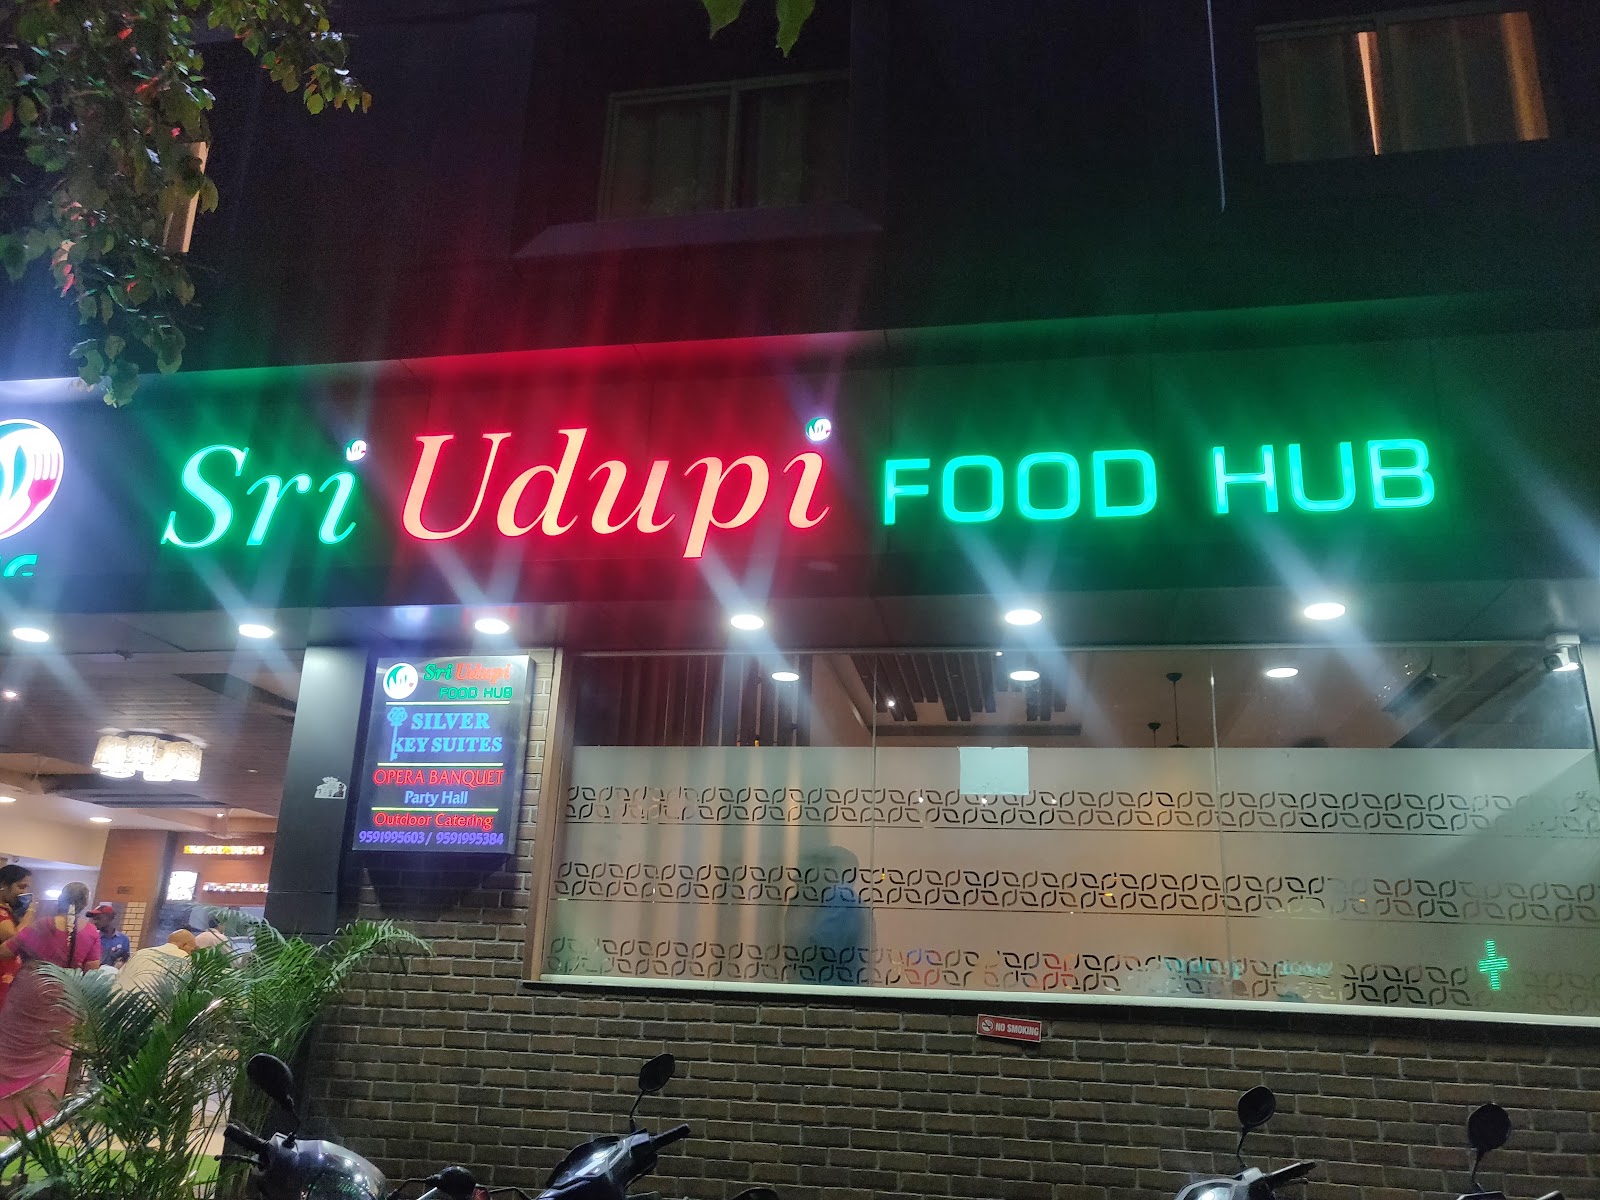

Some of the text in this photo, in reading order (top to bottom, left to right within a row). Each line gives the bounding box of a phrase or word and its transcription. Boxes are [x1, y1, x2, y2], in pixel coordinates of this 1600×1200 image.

[161, 416, 1436, 559] Sri Udupi FOOD HUB
[423, 663, 512, 684] Sri Udupi
[439, 687, 513, 699] FOOD HUB
[411, 712, 490, 730] SILVER
[392, 737, 503, 752] KEY SUITES
[373, 769, 505, 788] OPERA BANQUET
[404, 791, 468, 807] Party Hall
[373, 812, 493, 831] Outdoor Catering
[995, 1022, 1039, 1036] NO SMOKING
